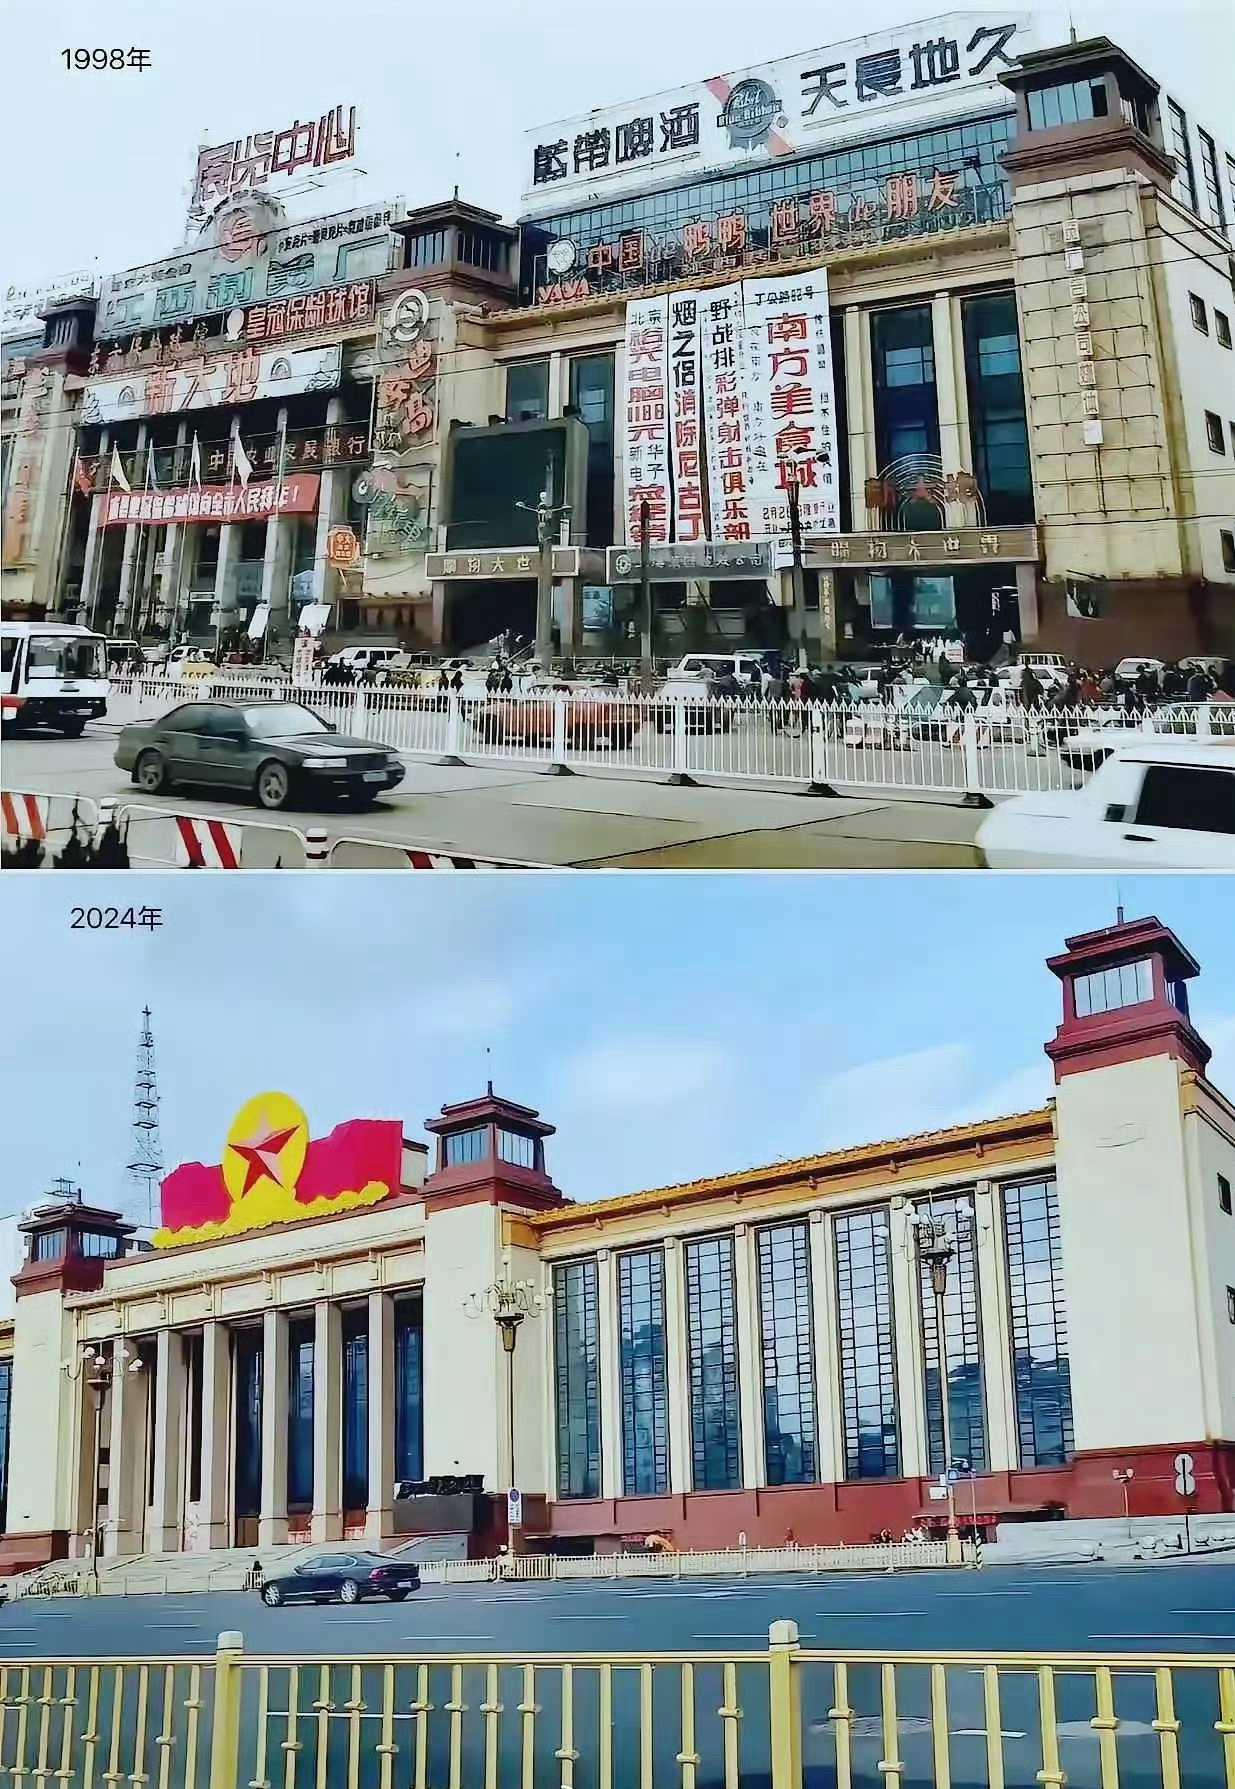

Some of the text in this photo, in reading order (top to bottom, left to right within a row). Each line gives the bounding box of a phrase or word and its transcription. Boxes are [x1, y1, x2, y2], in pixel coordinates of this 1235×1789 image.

[245, 283, 373, 339] 皇冠保龄球馆
[631, 308, 662, 327] 北京
[145, 345, 260, 414] 新大地
[765, 312, 819, 490] 南方美食城
[671, 299, 701, 542] 烟之侣消除尼古丁
[209, 435, 366, 472] 中农业发展银行
